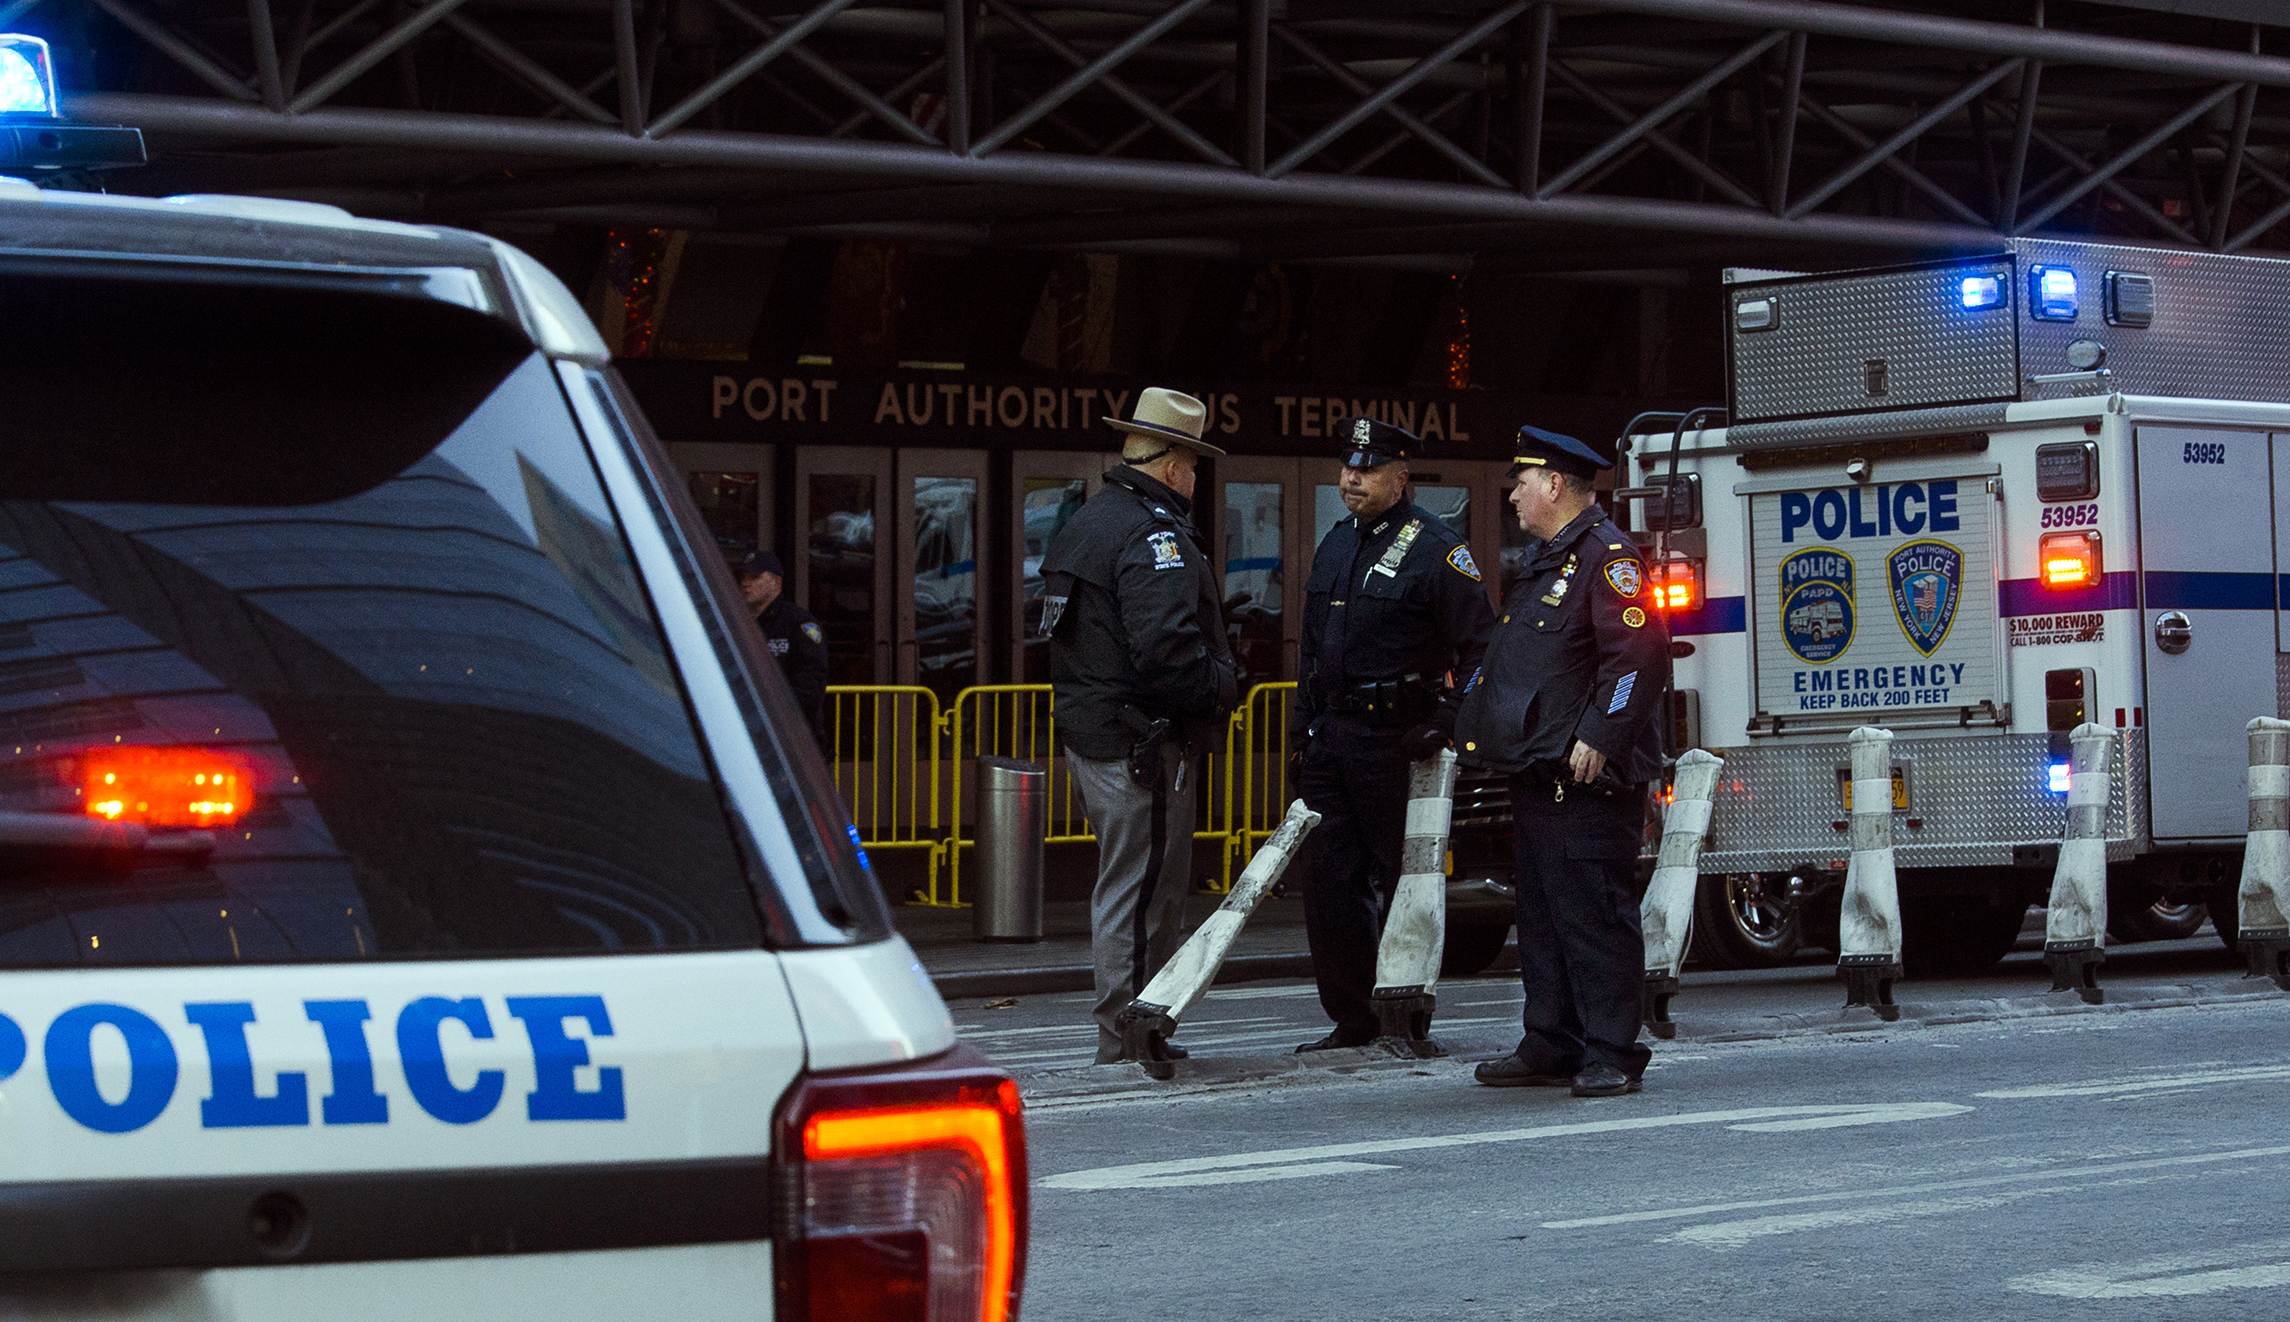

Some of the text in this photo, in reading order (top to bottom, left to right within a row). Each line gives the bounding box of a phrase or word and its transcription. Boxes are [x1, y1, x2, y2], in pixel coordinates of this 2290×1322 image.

[713, 376, 837, 422] PORT
[874, 382, 1130, 430] AUTHORITY
[2183, 442, 2225, 464] 53952
[1780, 480, 1960, 543] POLICE
[2040, 504, 2098, 528] 53952
[1895, 545, 1957, 564] PORT AUTHORITY
[1787, 556, 1846, 582] POLICE
[1897, 555, 1955, 579] POLICE
[1801, 588, 1834, 599] PAPD
[1895, 589, 1921, 640] NEW YORK
[1929, 583, 1958, 644] NEW JERSEY
[2009, 613, 2104, 632] $10,000 REWARD
[2010, 637, 2027, 647] CALL
[2029, 635, 2051, 646] 1-800
[1794, 663, 1966, 692] EMERGENCY
[1800, 688, 1950, 710] KEEP BACK 200 FEET
